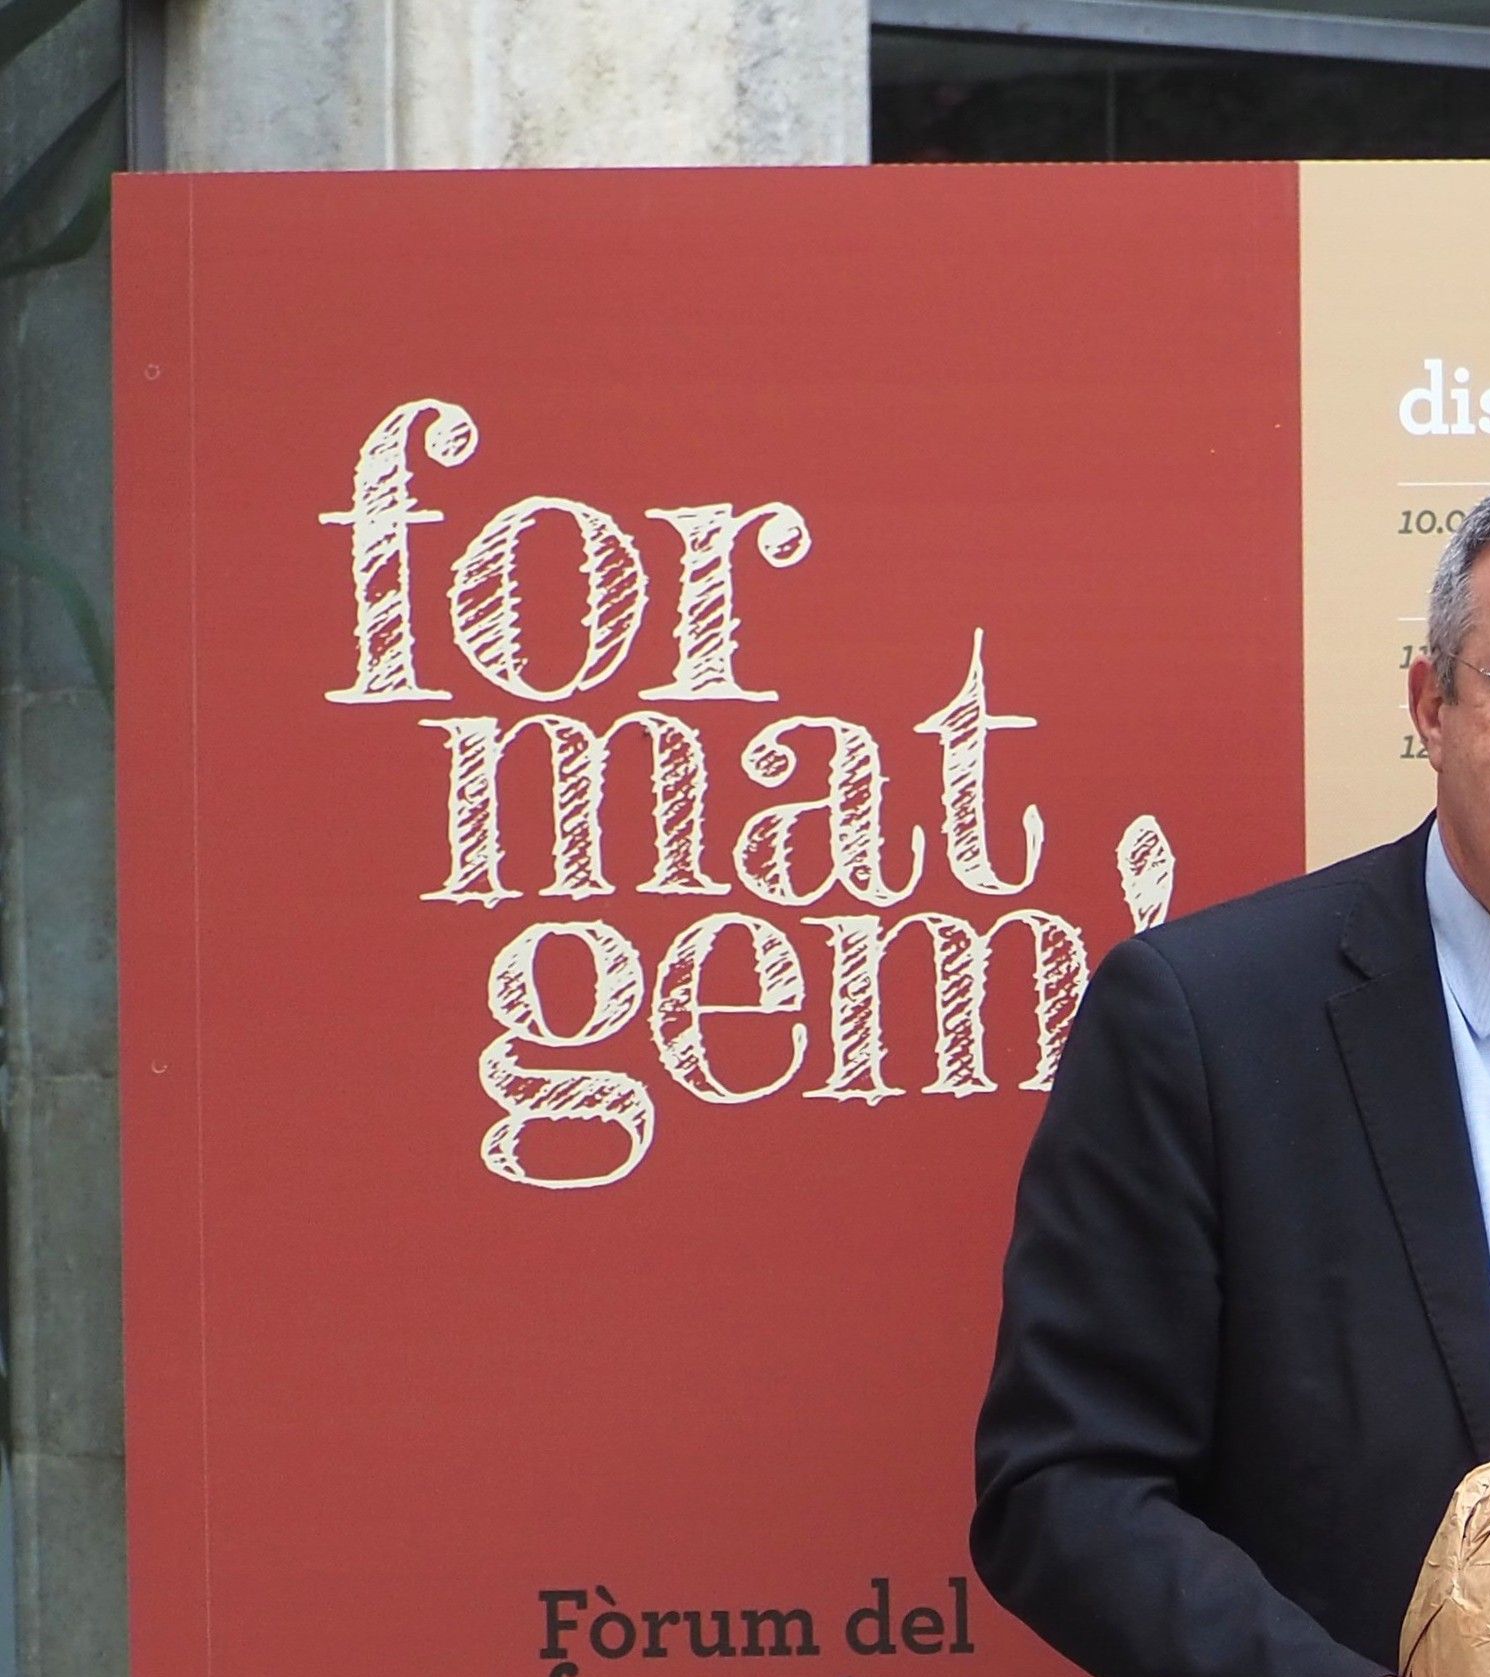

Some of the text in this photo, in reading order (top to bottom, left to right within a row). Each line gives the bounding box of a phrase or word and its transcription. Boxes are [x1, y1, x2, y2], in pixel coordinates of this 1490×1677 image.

[317, 398, 812, 704] for
[419, 627, 1044, 907] mat
[538, 1576, 976, 1659] Fòrum del
